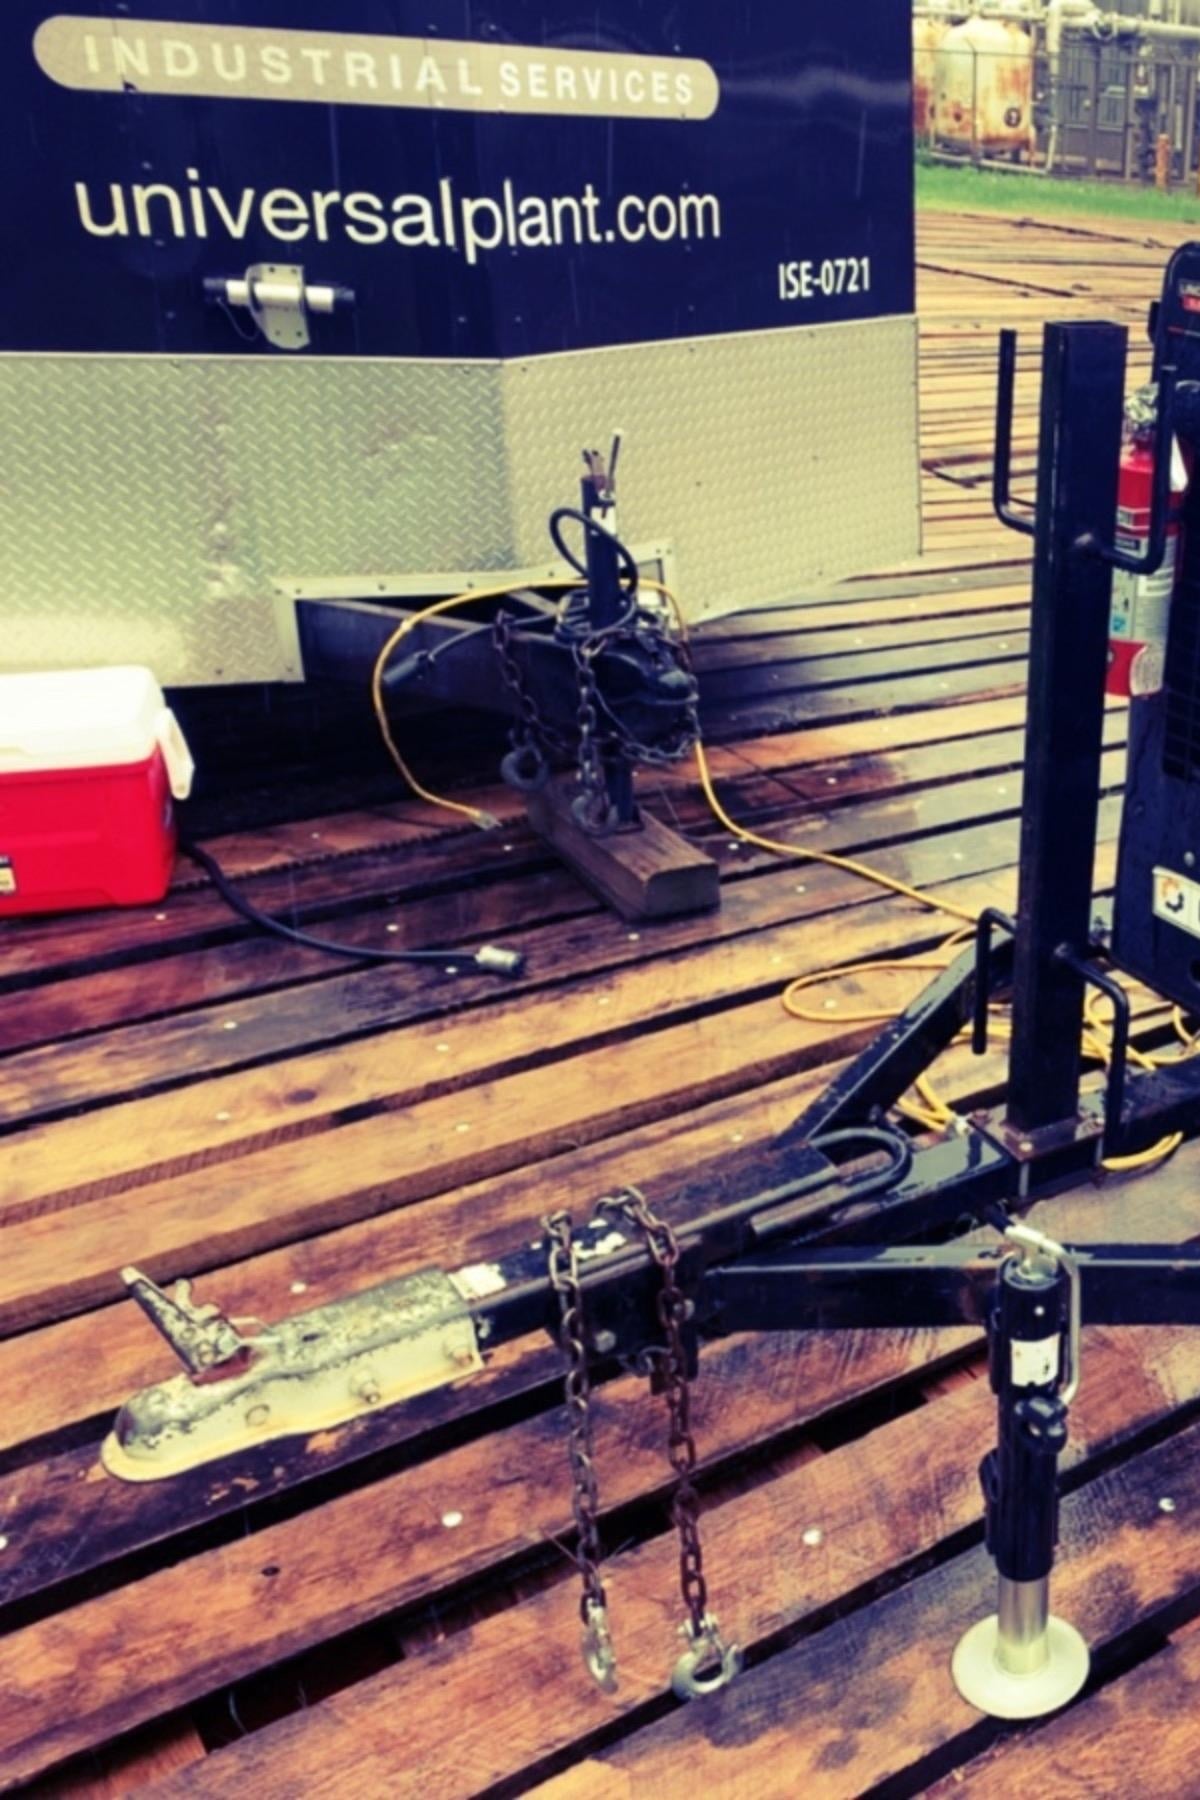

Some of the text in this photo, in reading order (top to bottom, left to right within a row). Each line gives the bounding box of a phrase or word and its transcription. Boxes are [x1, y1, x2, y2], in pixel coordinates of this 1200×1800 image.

[84, 34, 694, 105] INDUSTRIAL SERVICES
[75, 168, 721, 264] universalplant.com
[778, 257, 871, 299] ISE-0721
